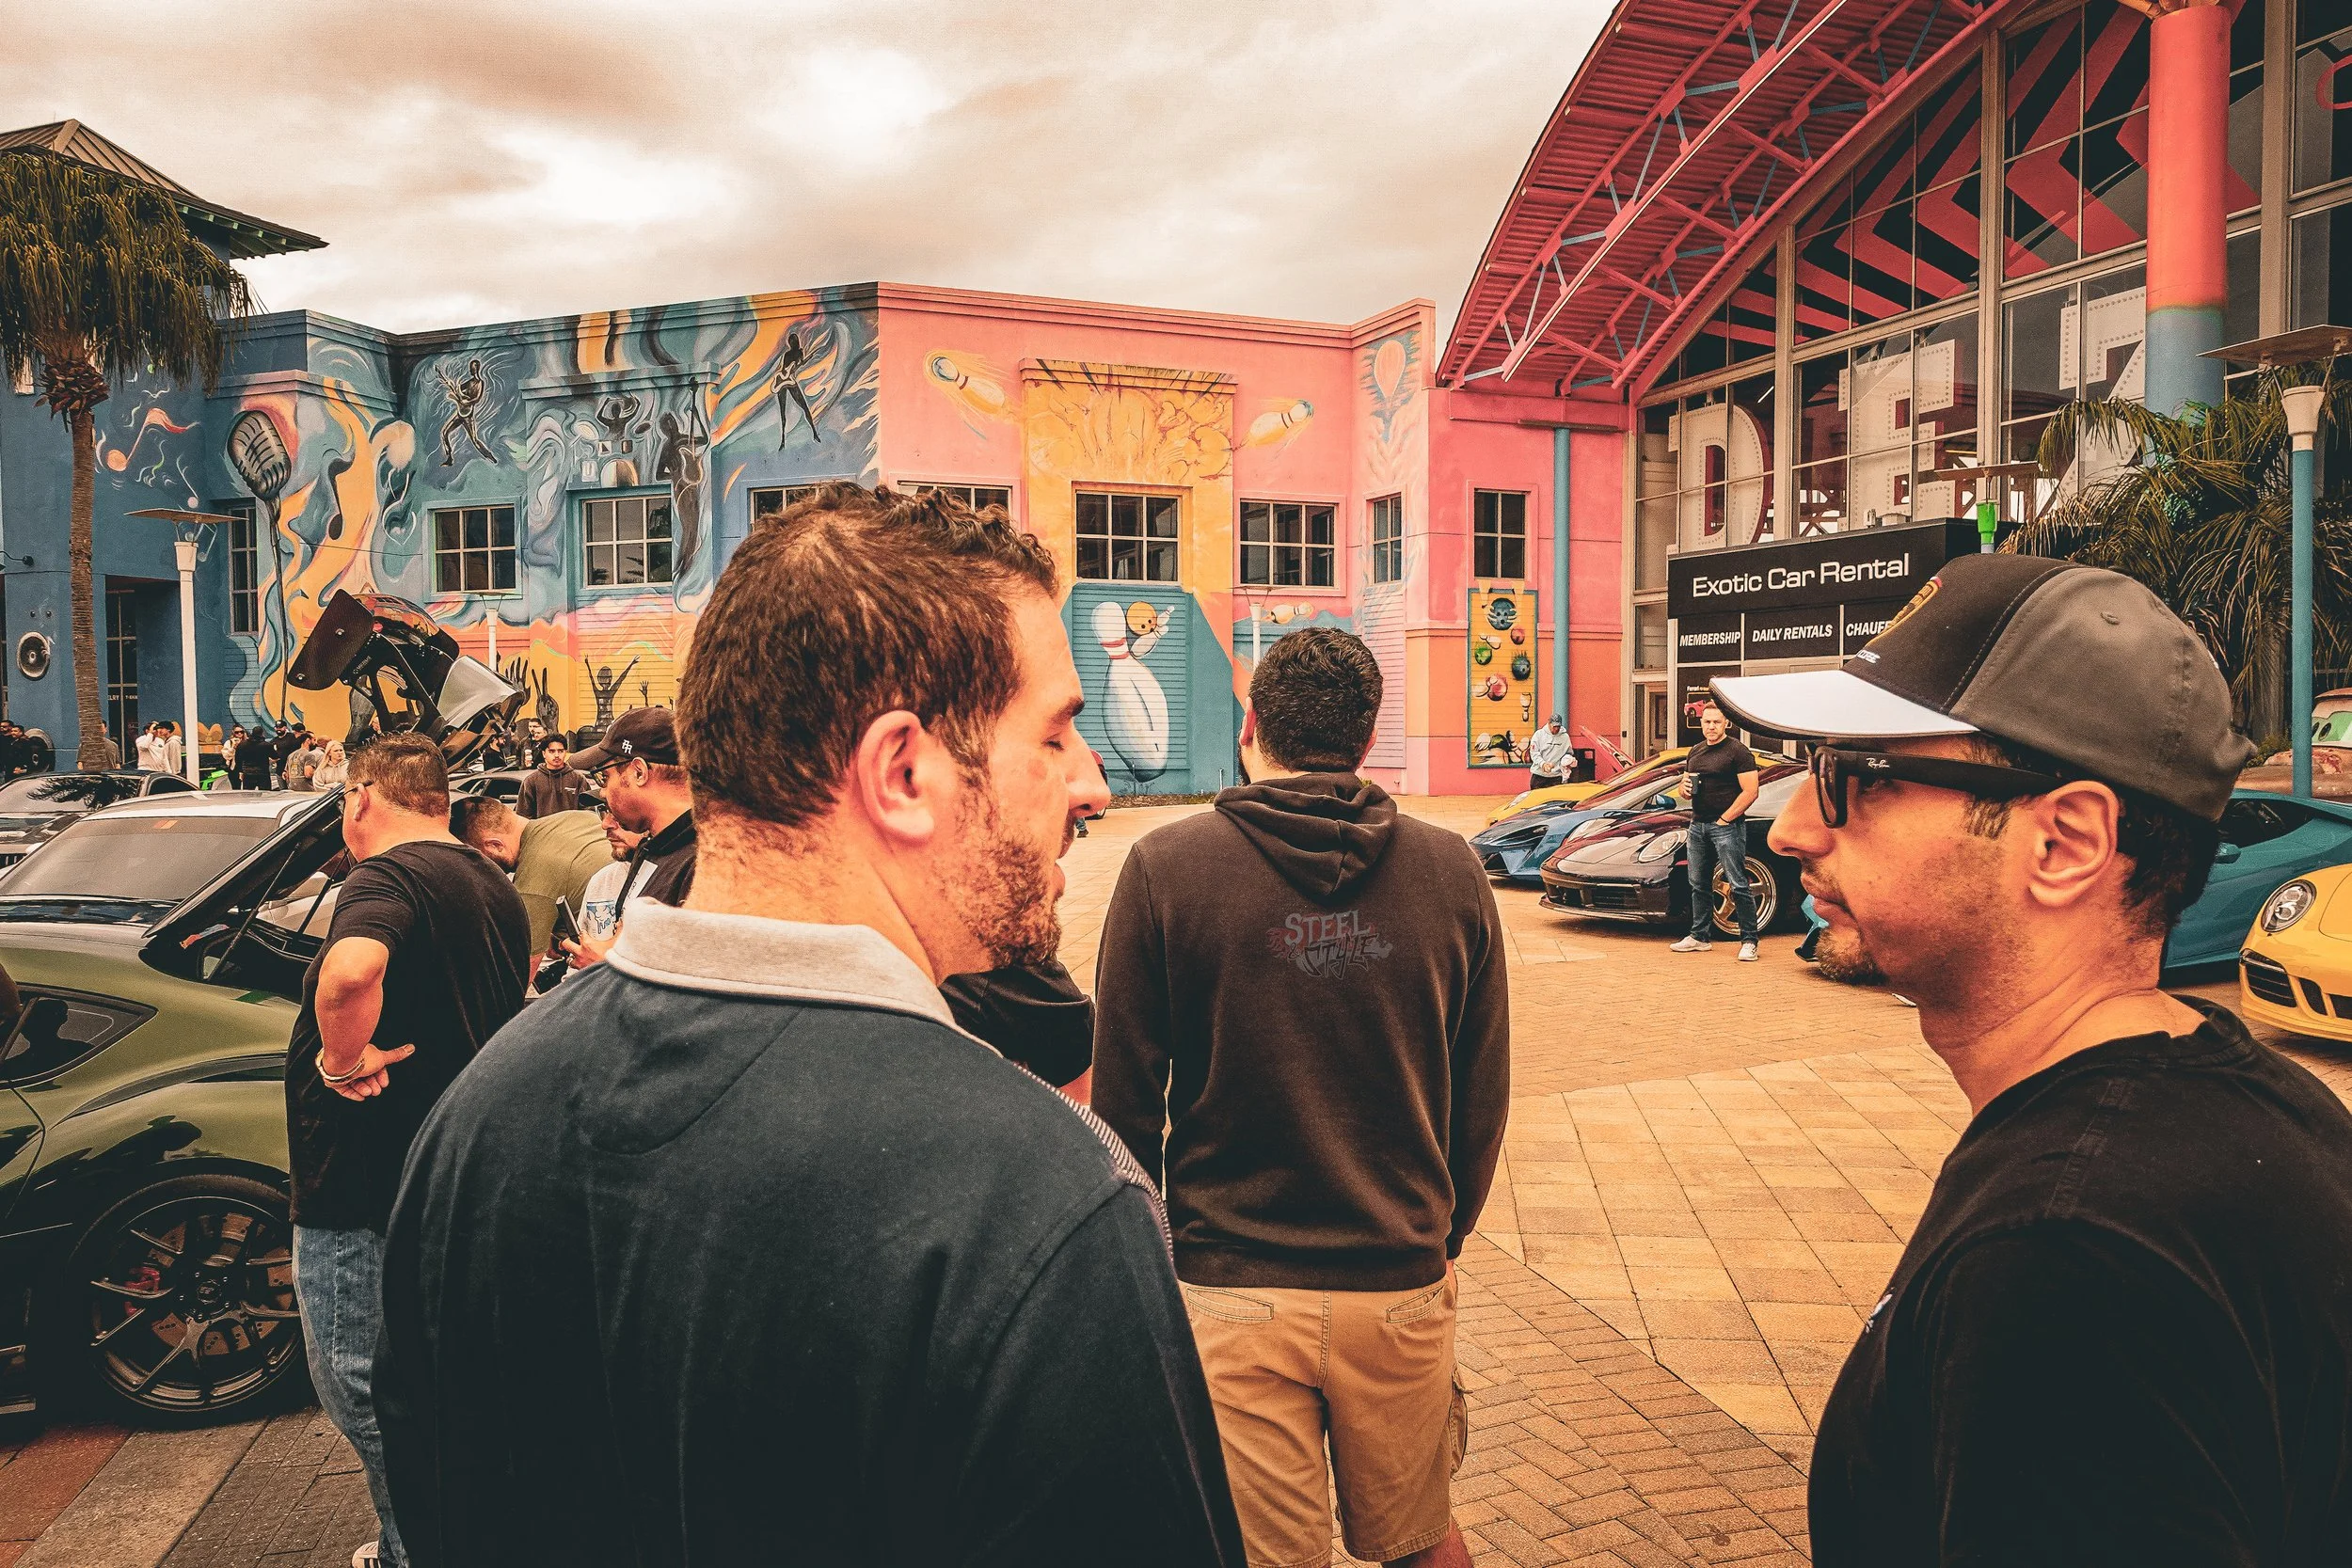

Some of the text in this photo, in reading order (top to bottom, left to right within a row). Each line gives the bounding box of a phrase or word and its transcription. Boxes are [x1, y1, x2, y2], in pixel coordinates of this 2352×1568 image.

[1692, 553, 1910, 598] Exotic Car Rental
[1679, 632, 1741, 647] MEMBERSHIP
[1752, 624, 1834, 642] DAILY RENTALS
[1284, 910, 1371, 947] STEEL
[1287, 932, 1380, 980] & STYLE
